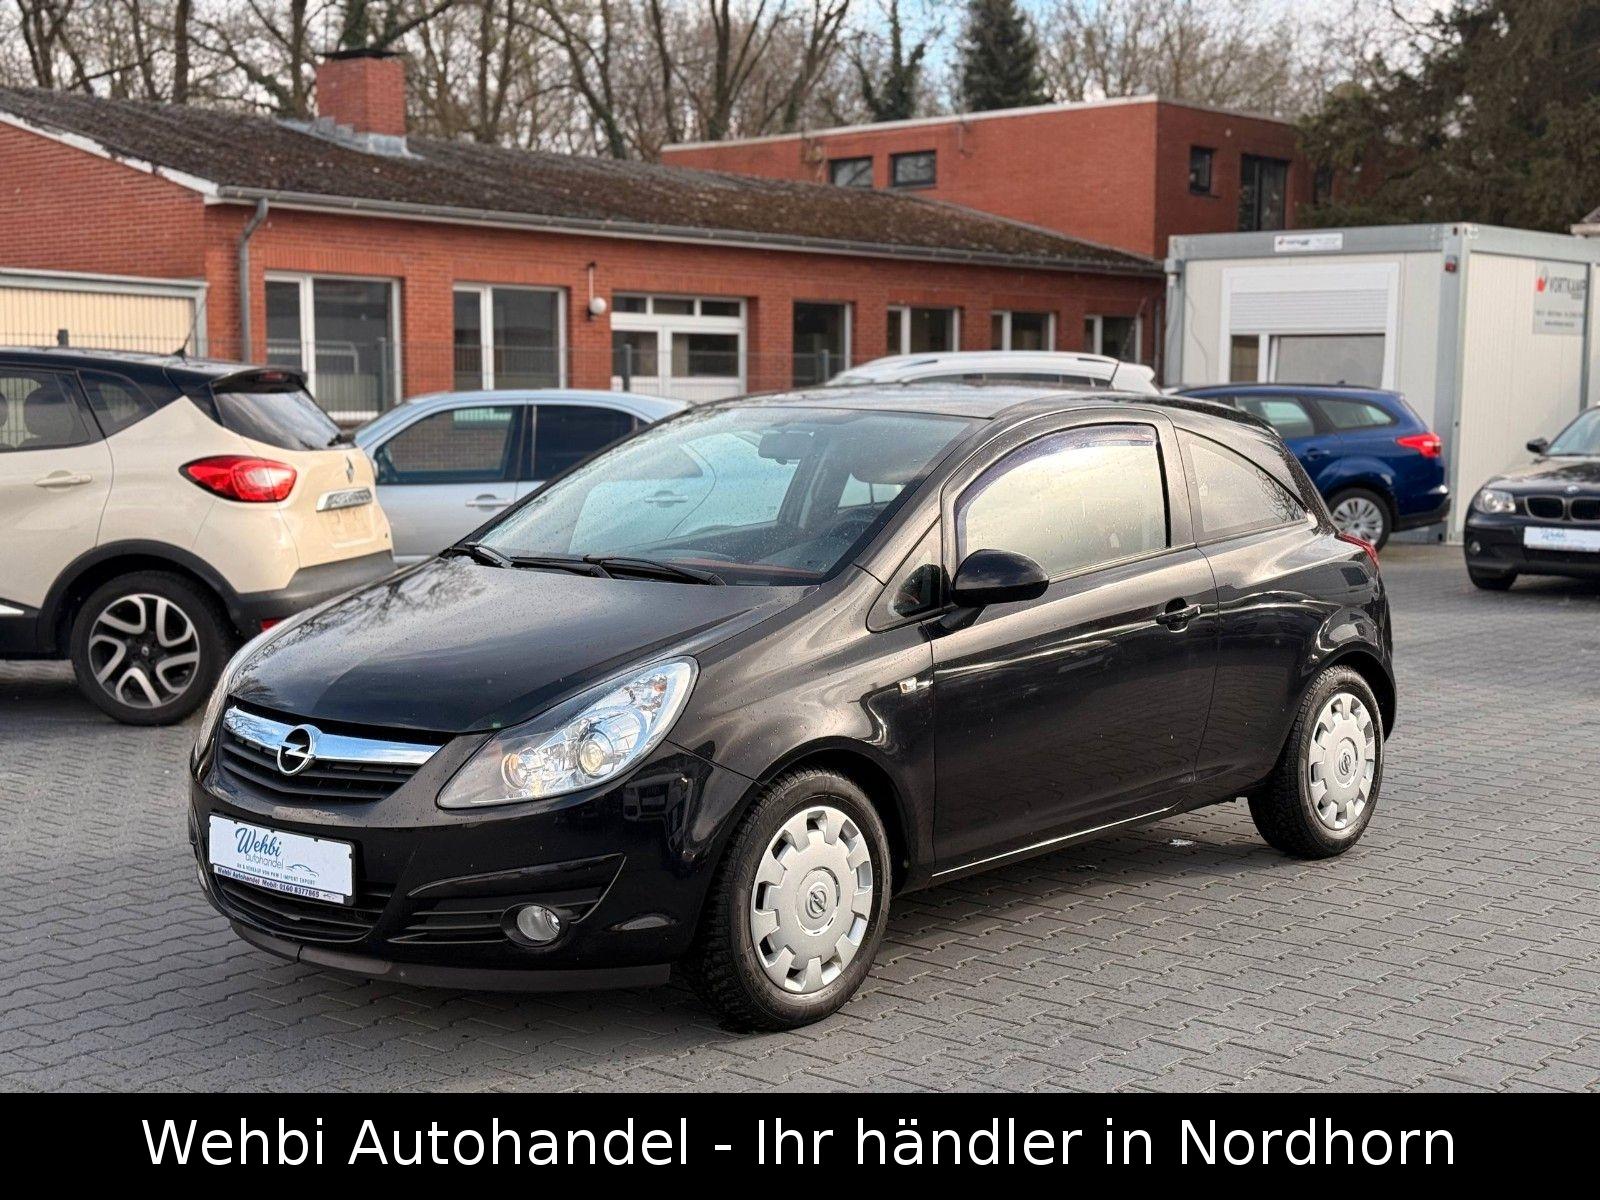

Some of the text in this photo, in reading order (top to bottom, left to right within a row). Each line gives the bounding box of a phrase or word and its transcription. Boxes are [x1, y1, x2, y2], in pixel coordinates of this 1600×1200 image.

[235, 827, 282, 857] Wehbi
[245, 853, 284, 869] autohandel
[218, 867, 231, 876] Wehbi
[233, 872, 261, 885] Autohandel
[280, 884, 294, 893] 0160
